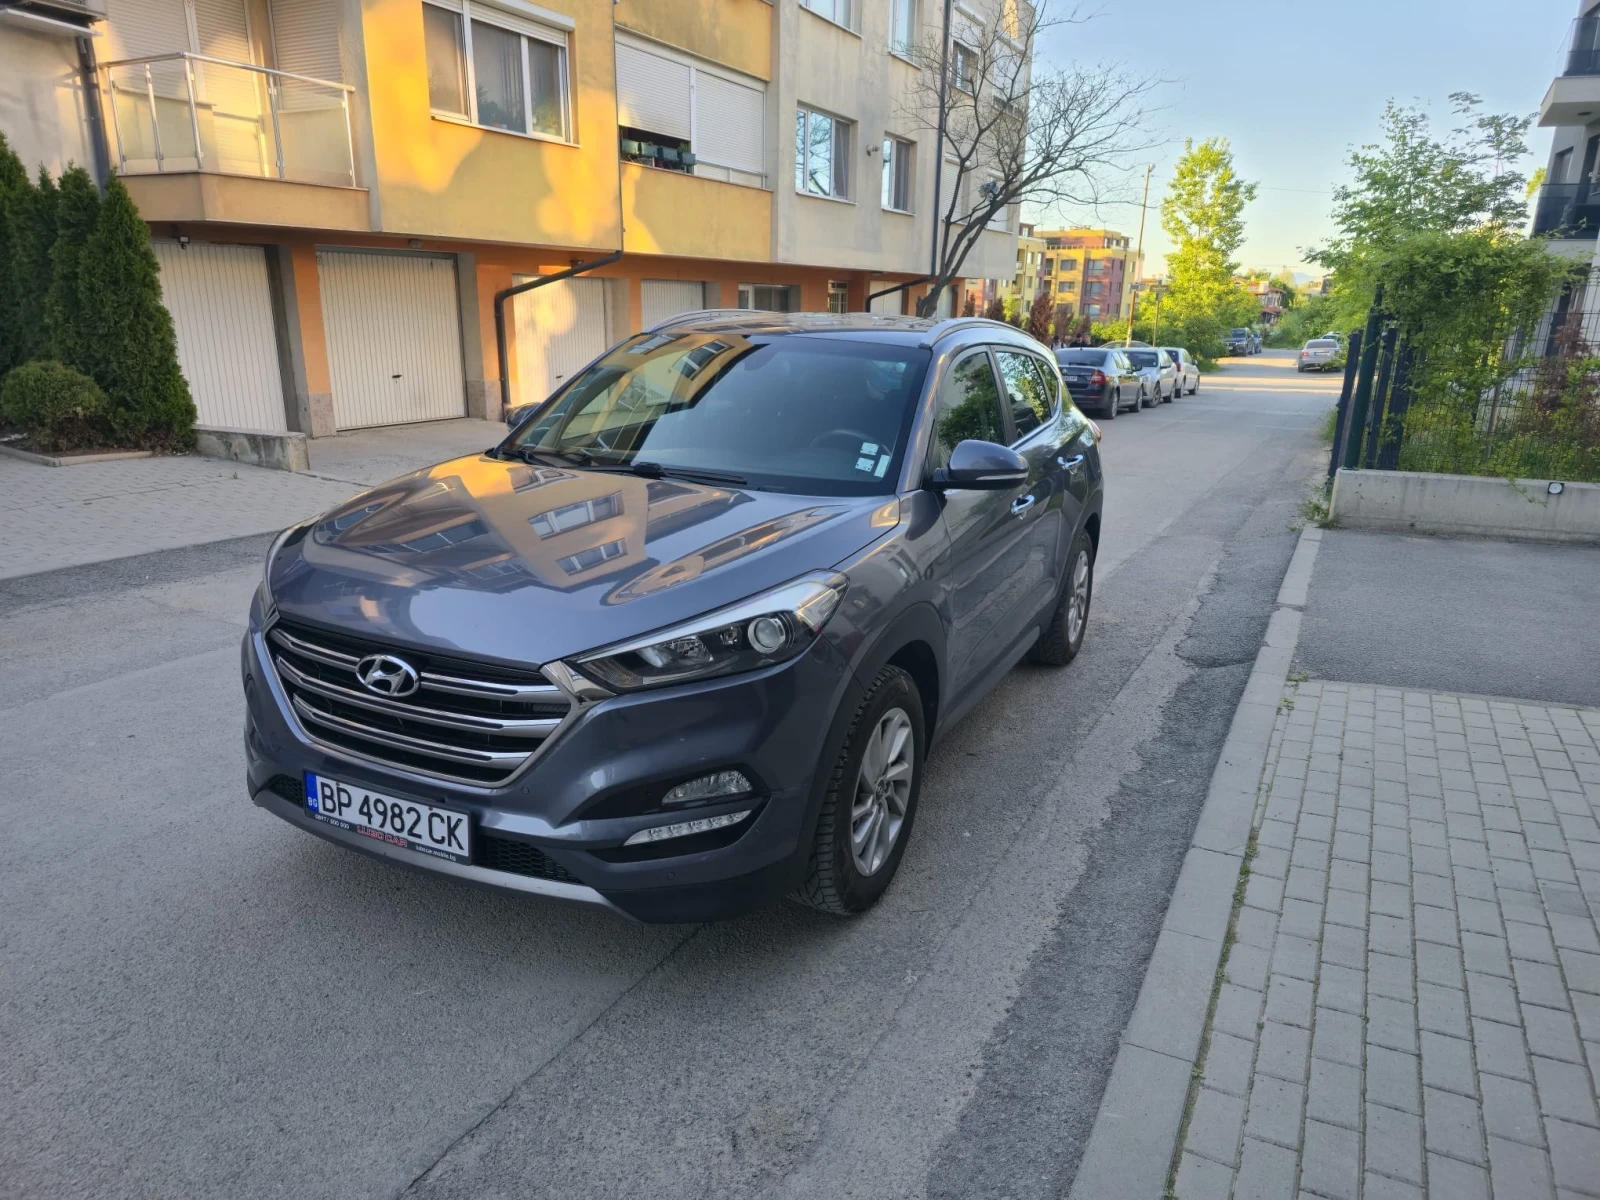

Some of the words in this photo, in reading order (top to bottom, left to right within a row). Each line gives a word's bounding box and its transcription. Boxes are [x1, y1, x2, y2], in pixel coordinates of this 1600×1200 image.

[307, 796, 318, 807] BG
[320, 781, 352, 816] BP
[358, 794, 423, 839] 4982
[428, 812, 464, 851] CK
